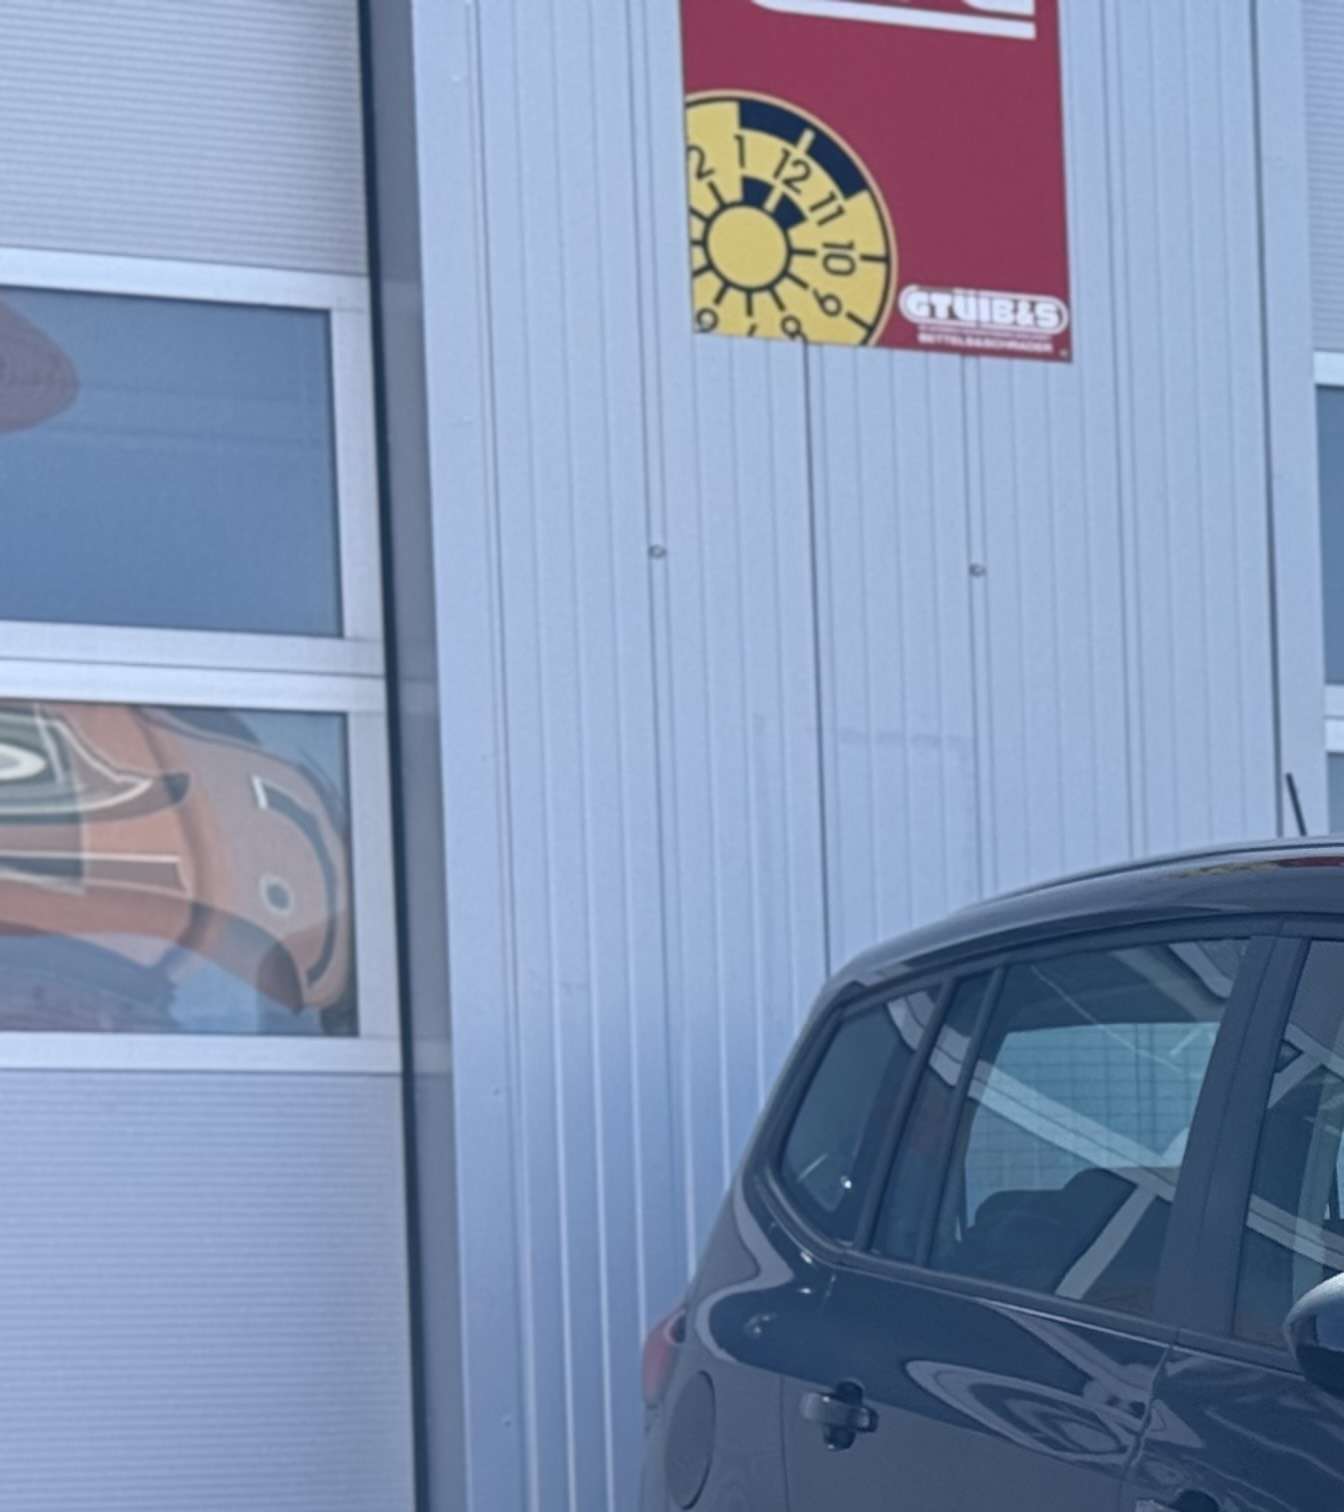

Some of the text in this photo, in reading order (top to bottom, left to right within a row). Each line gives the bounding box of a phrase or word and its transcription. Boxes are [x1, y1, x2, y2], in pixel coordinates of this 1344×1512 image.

[773, 148, 812, 195] 12
[808, 191, 846, 227] 11
[821, 239, 857, 277] 10
